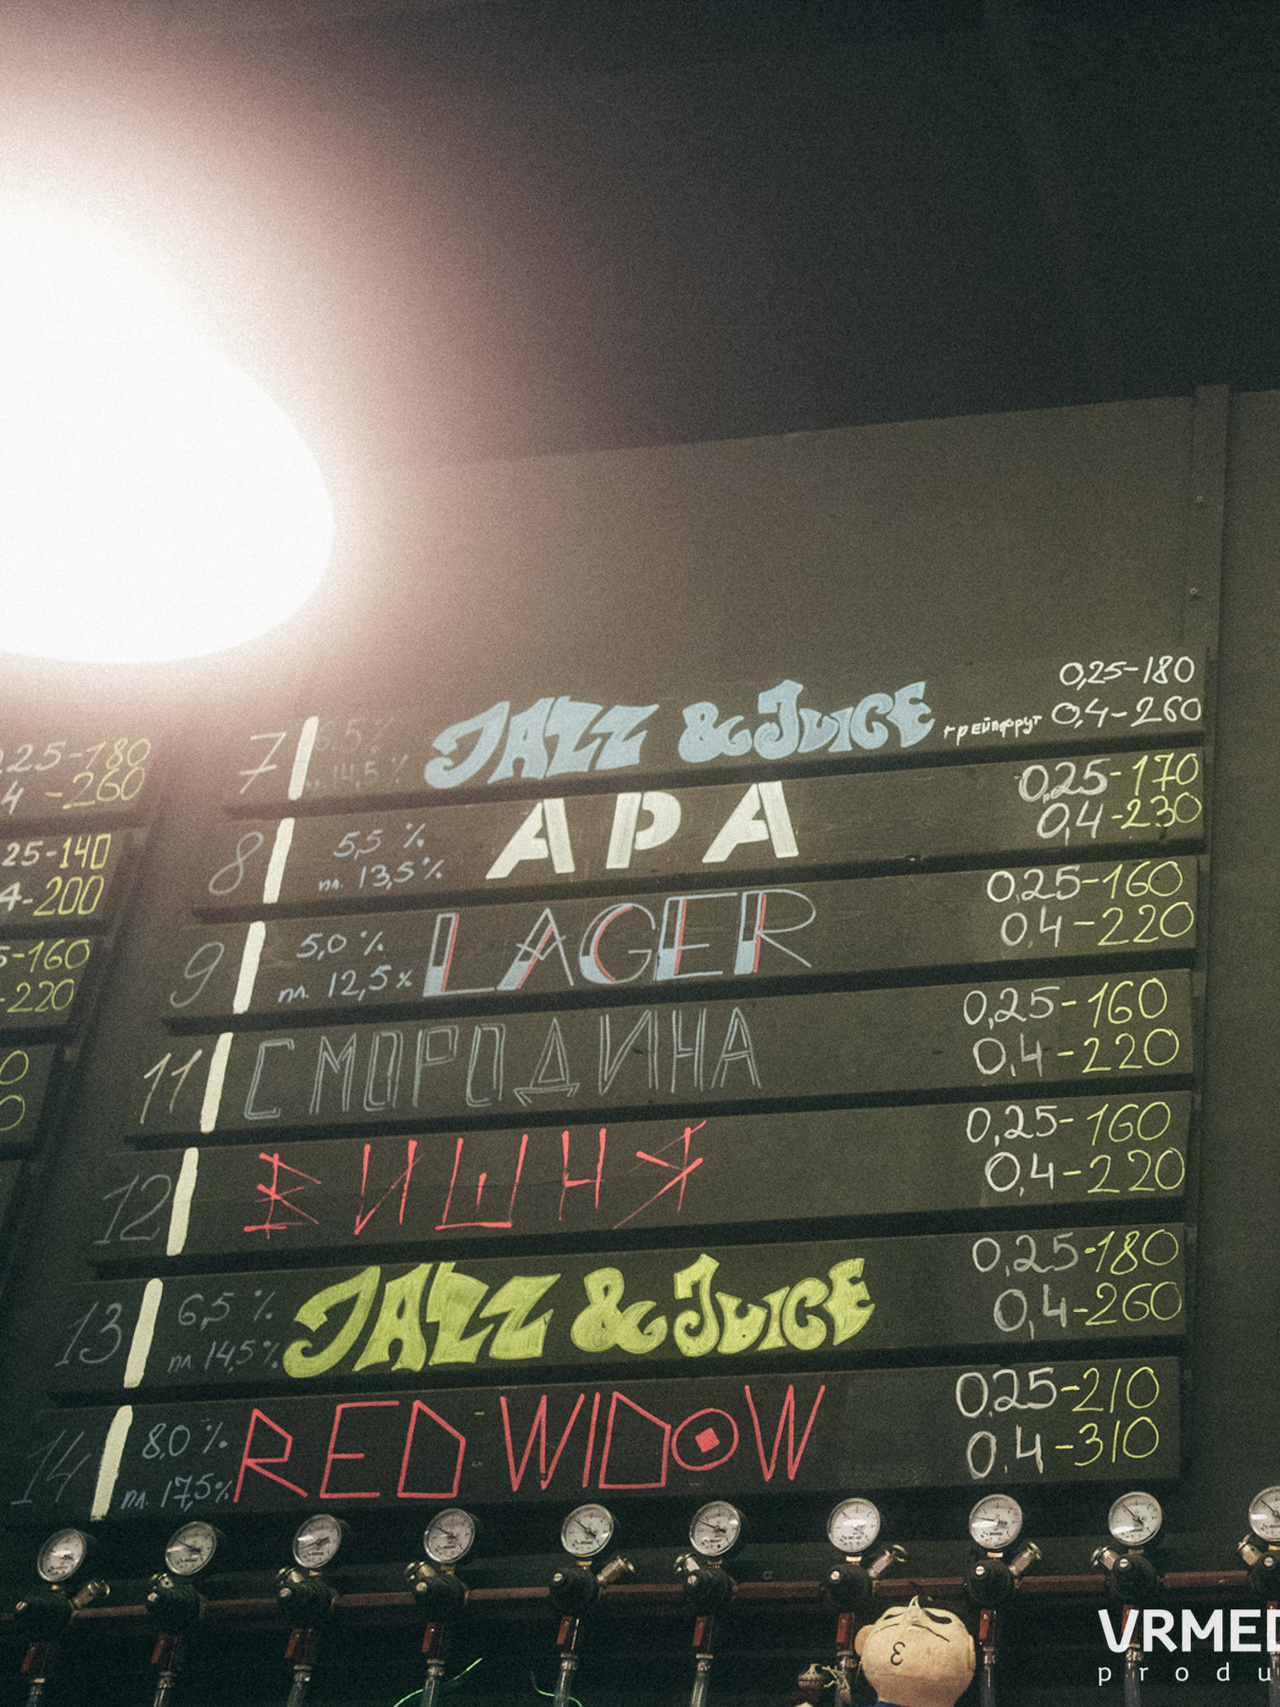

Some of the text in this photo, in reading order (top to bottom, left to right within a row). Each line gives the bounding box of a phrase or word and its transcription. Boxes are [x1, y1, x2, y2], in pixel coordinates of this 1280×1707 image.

[238, 730, 287, 795] 7
[423, 695, 659, 789] JAZZ
[678, 701, 753, 763] &
[208, 831, 264, 895] 8
[486, 781, 800, 879] APA
[169, 941, 225, 1008] 9
[423, 888, 816, 997] LAGER
[139, 1048, 203, 1125] 11
[244, 1007, 762, 1120] СМОРОДИНА
[93, 1173, 172, 1246] 12
[243, 1120, 707, 1240] ВИШНЯ
[54, 1301, 123, 1367] 13
[283, 1262, 561, 1378] JAZZ
[571, 1267, 668, 1355] &
[10, 1429, 92, 1506] 14
[234, 1384, 826, 1503] RED WIDOW
